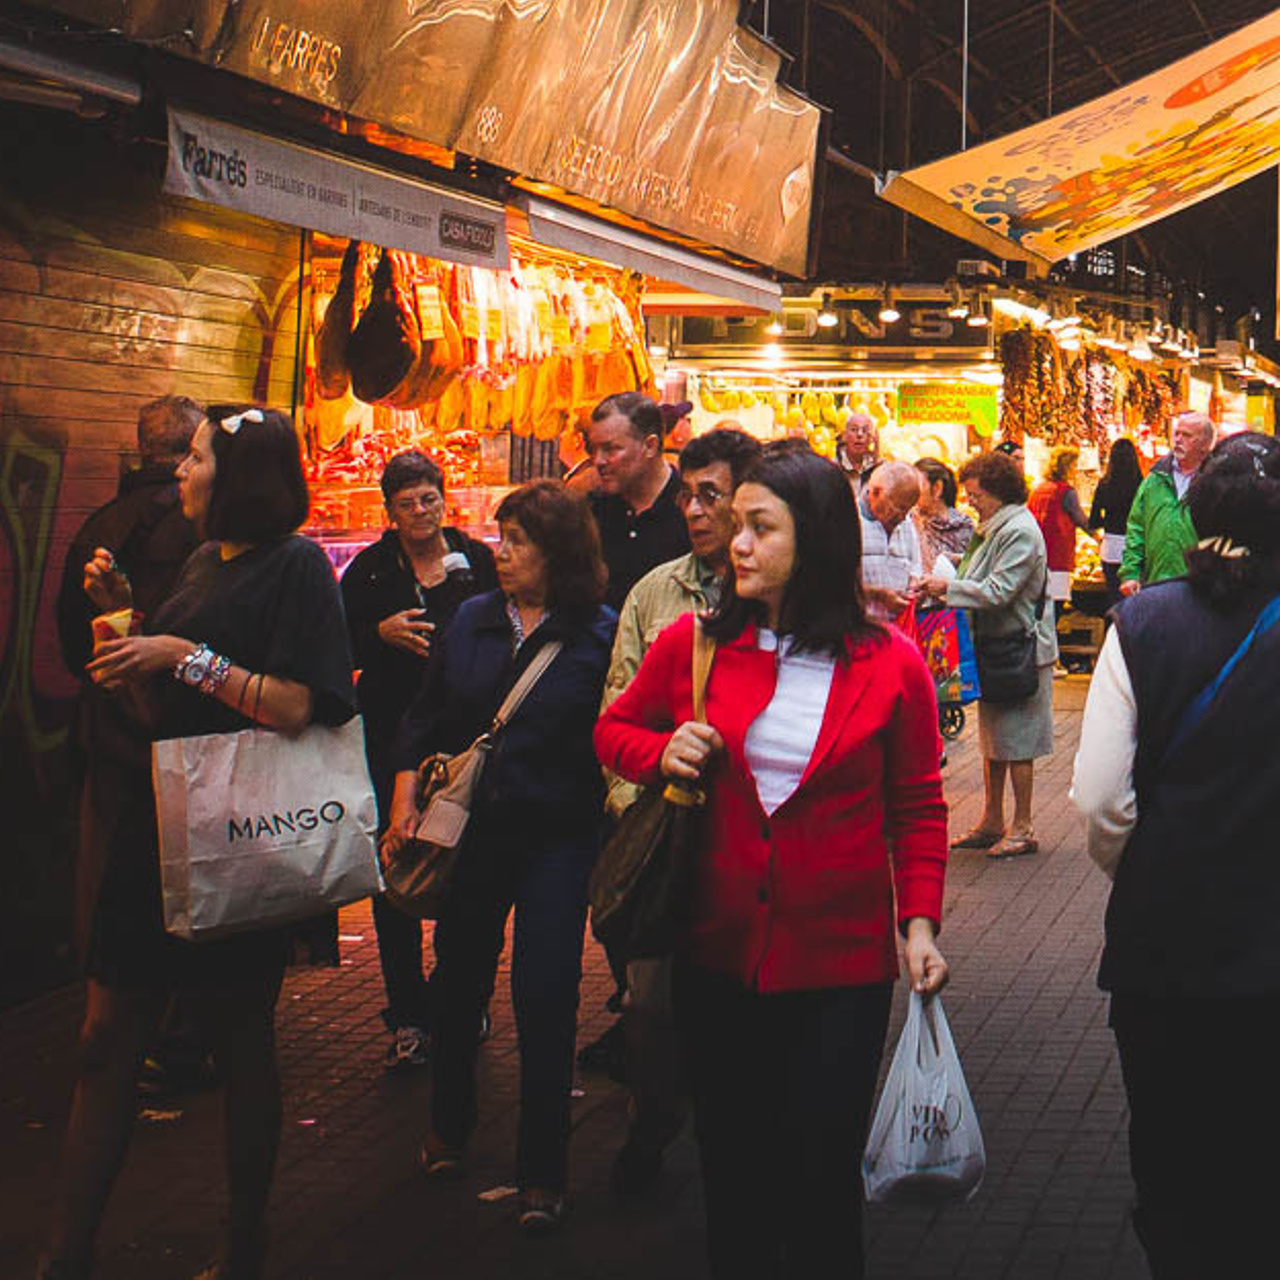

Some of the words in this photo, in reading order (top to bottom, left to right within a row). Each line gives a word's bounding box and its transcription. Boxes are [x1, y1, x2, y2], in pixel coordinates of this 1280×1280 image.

[182, 131, 248, 188] Farrés
[911, 397, 966, 409] TROPICAL
[227, 799, 346, 843] MANGO
